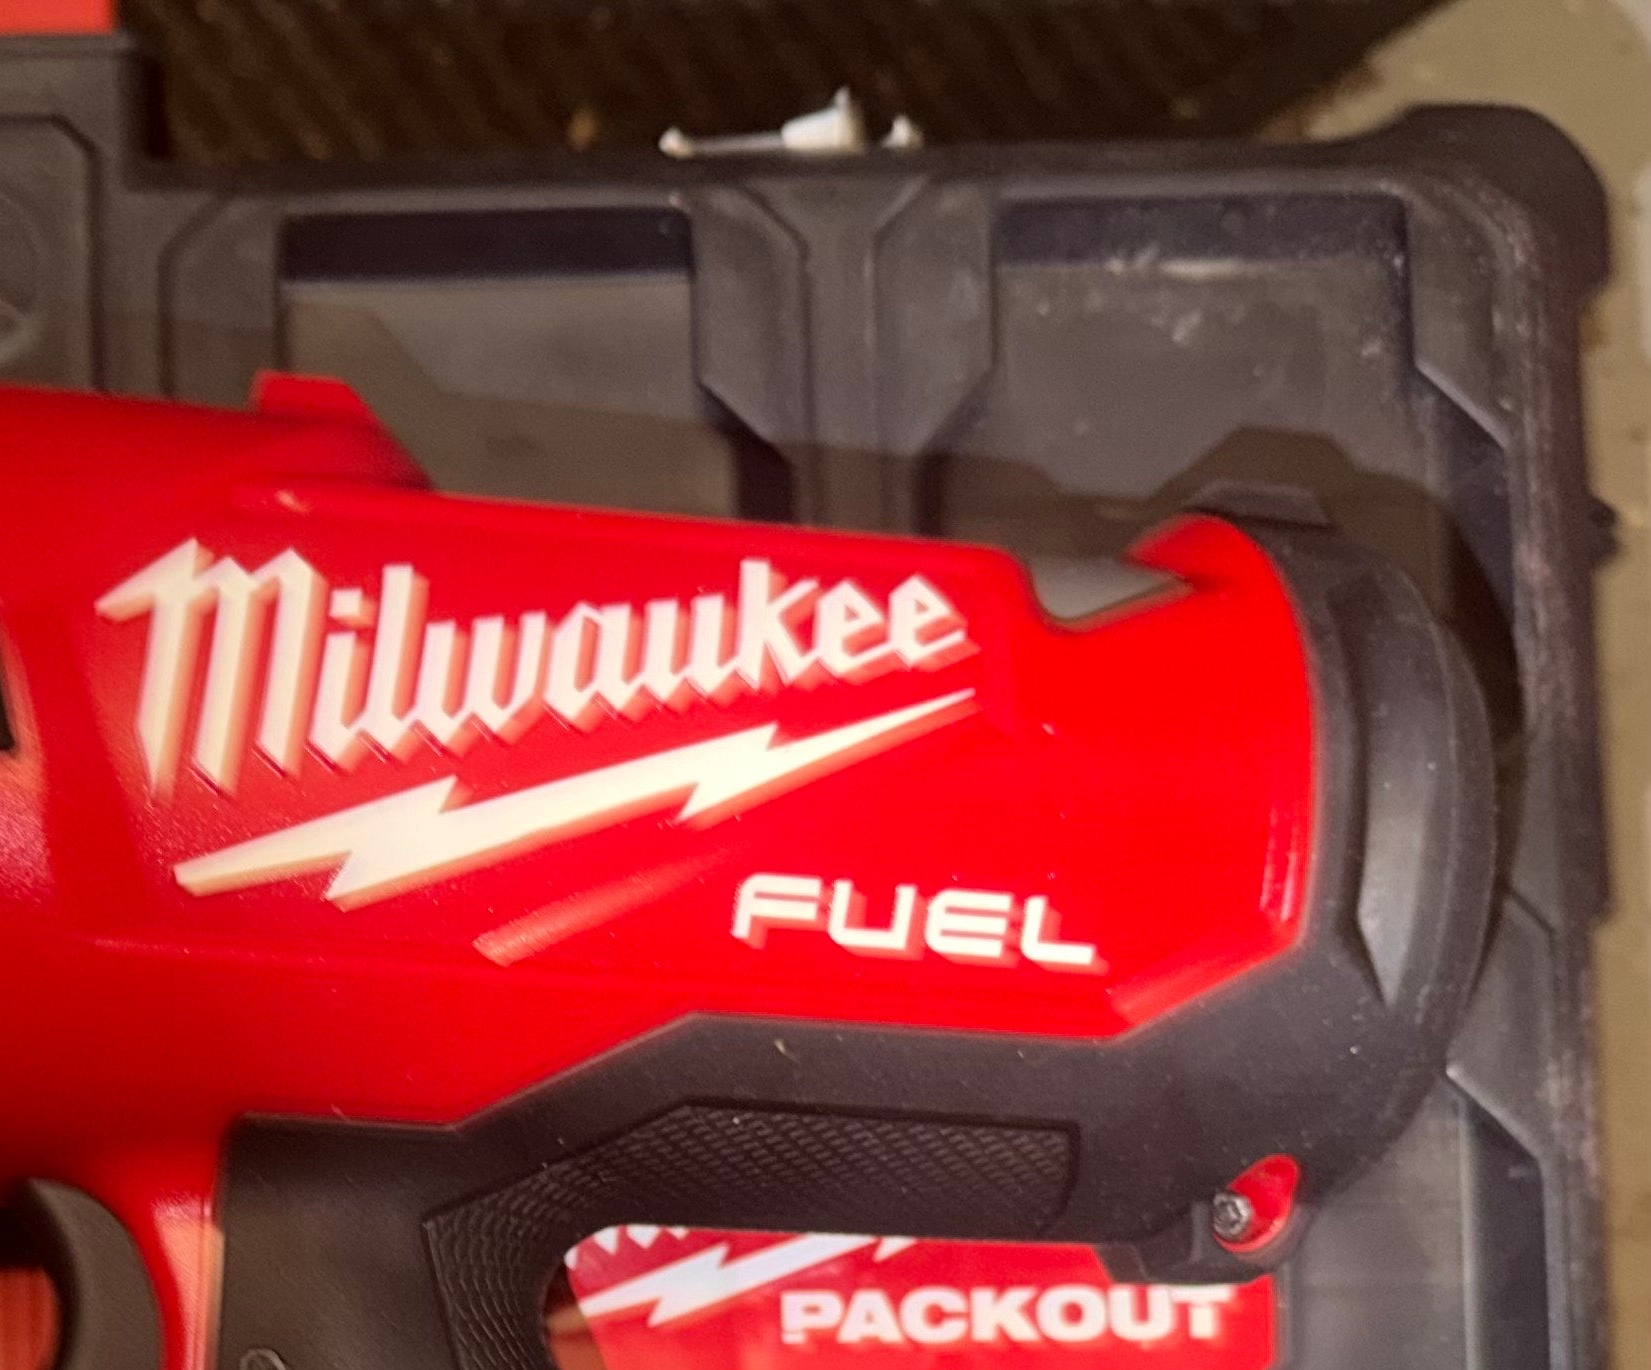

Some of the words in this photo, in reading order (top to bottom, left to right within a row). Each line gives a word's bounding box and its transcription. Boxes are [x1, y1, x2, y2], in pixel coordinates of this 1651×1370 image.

[95, 536, 976, 798] Milwaukee
[732, 871, 1102, 966] FUEL
[780, 1284, 1240, 1346] PACKOUT
